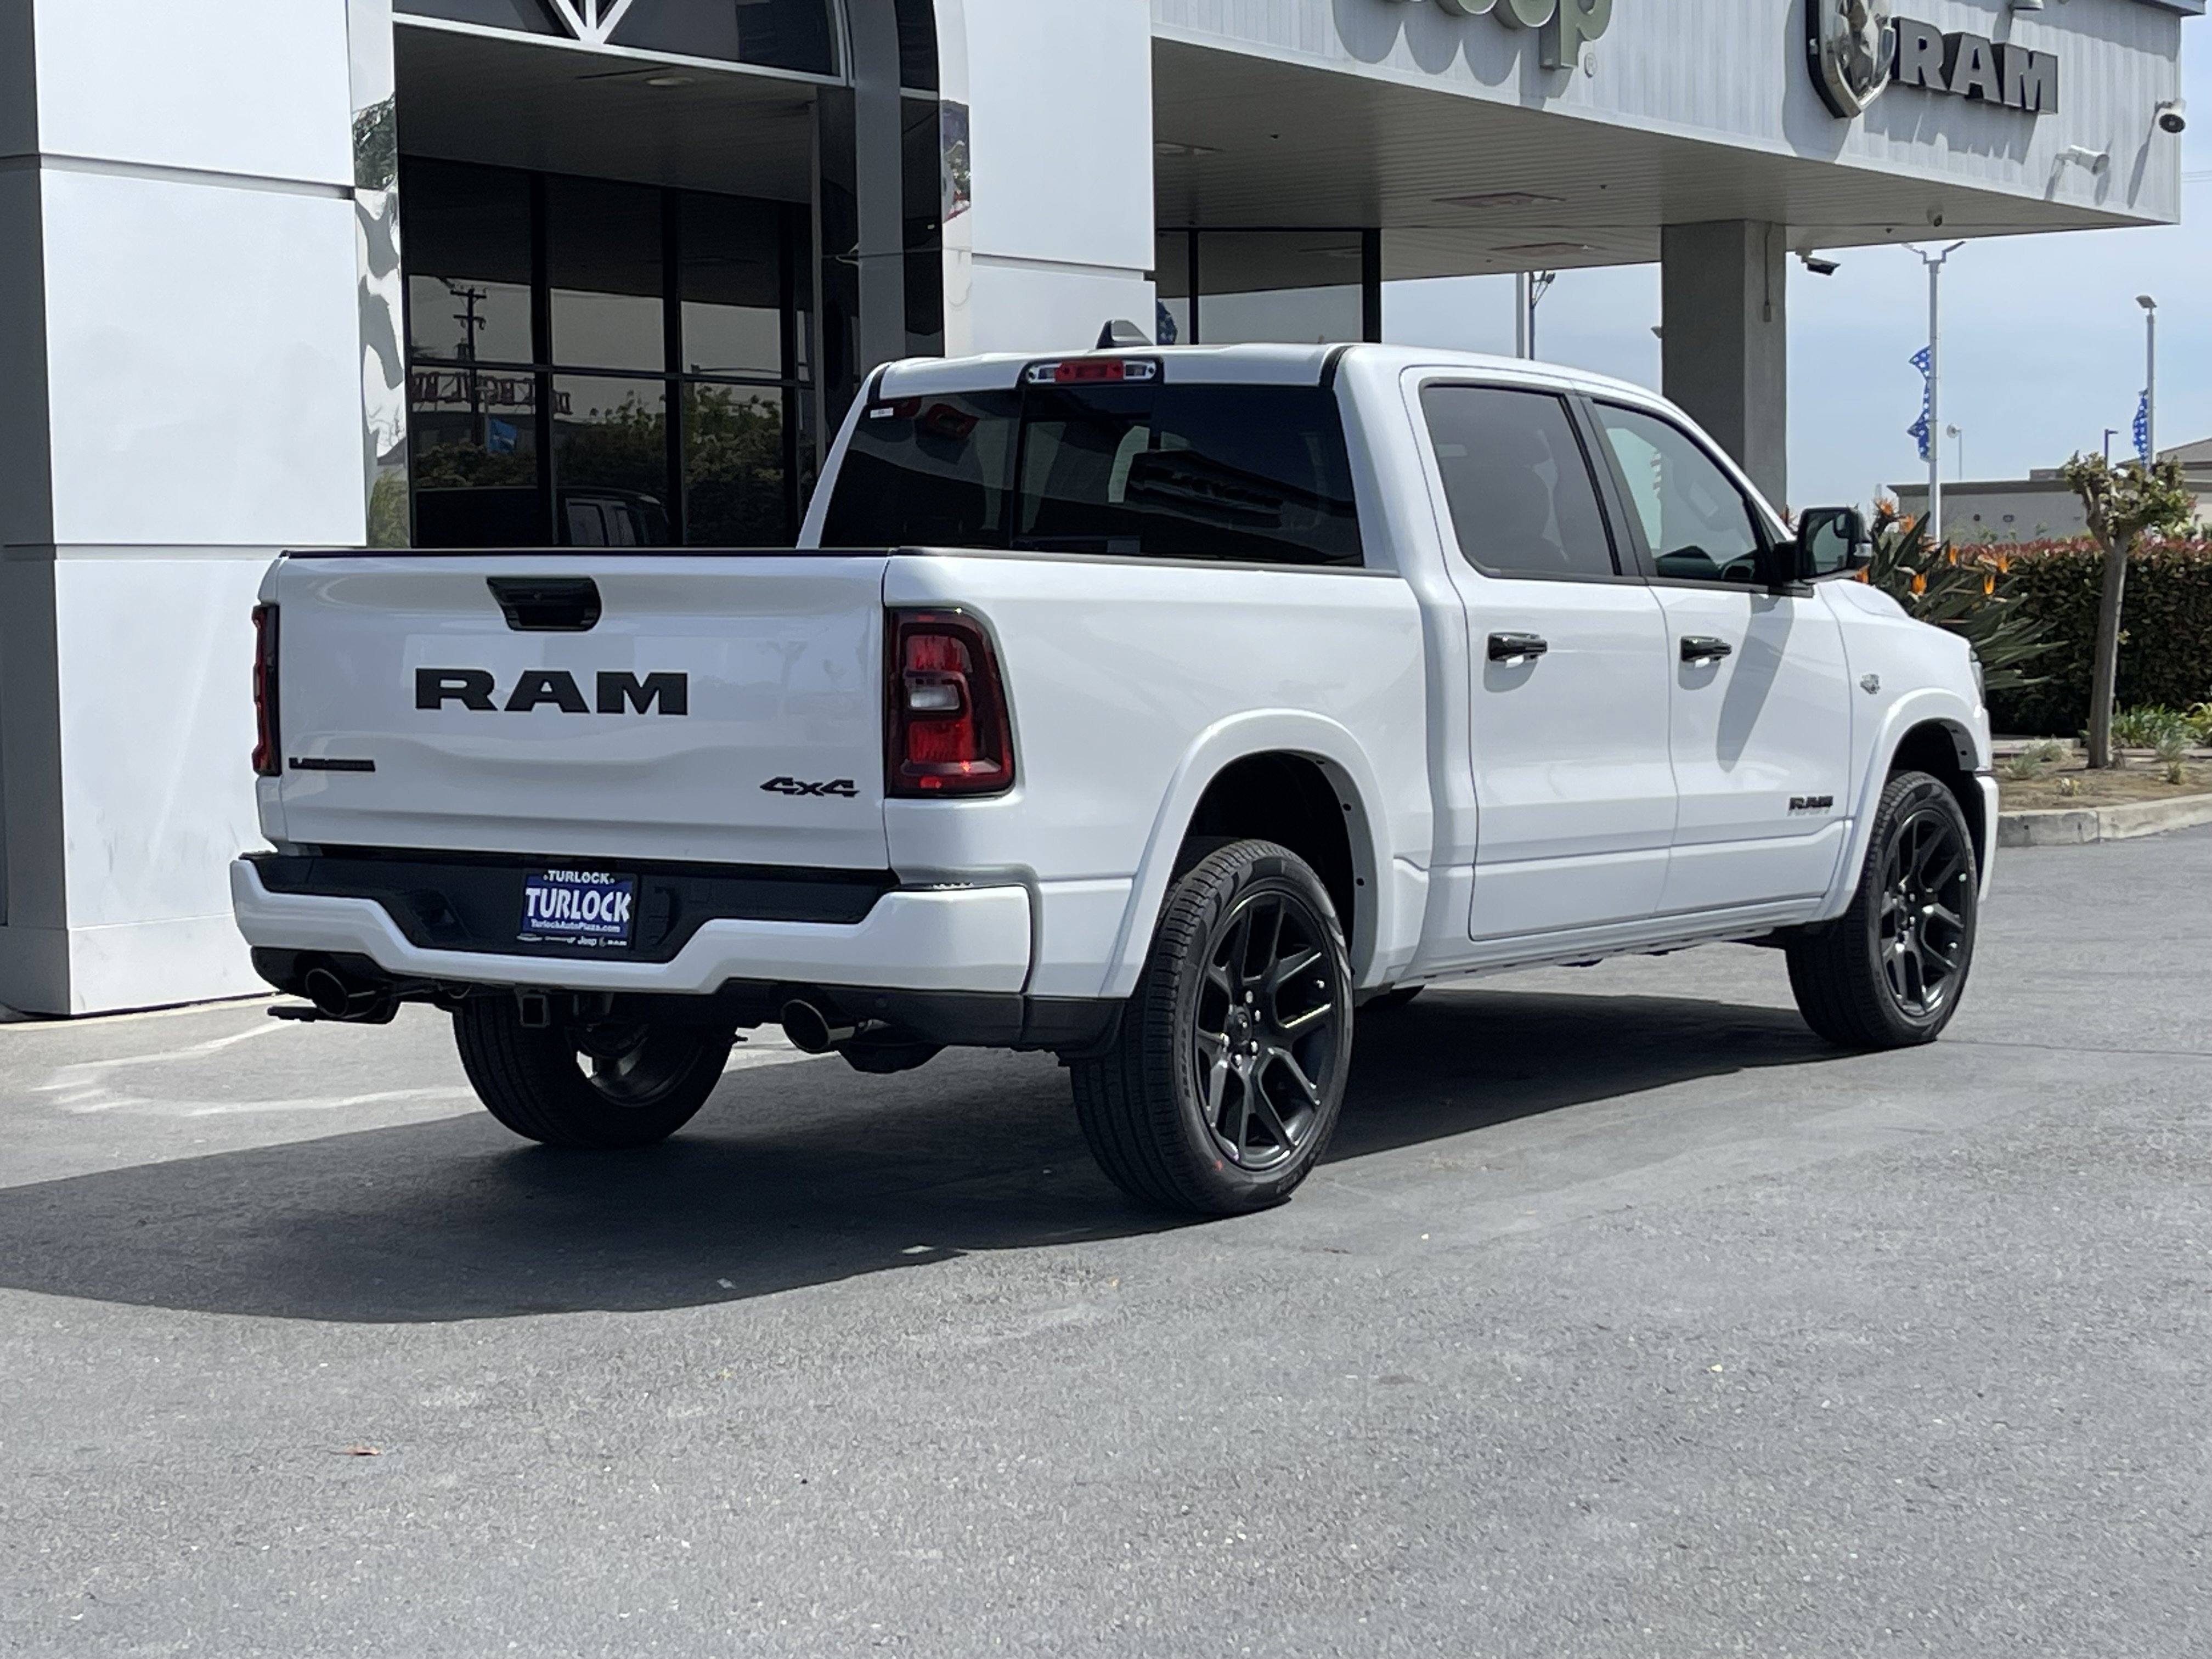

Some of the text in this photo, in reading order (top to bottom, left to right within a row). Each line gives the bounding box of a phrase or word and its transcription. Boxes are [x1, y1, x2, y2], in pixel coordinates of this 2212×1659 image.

[1895, 16, 2058, 114] RAM
[415, 668, 688, 715] RAM
[759, 776, 860, 798] 4x4
[1788, 795, 1833, 811] RAM
[548, 870, 611, 884] TURLOCK
[525, 887, 631, 922] TURLOCK
[577, 935, 597, 946] Jeep
